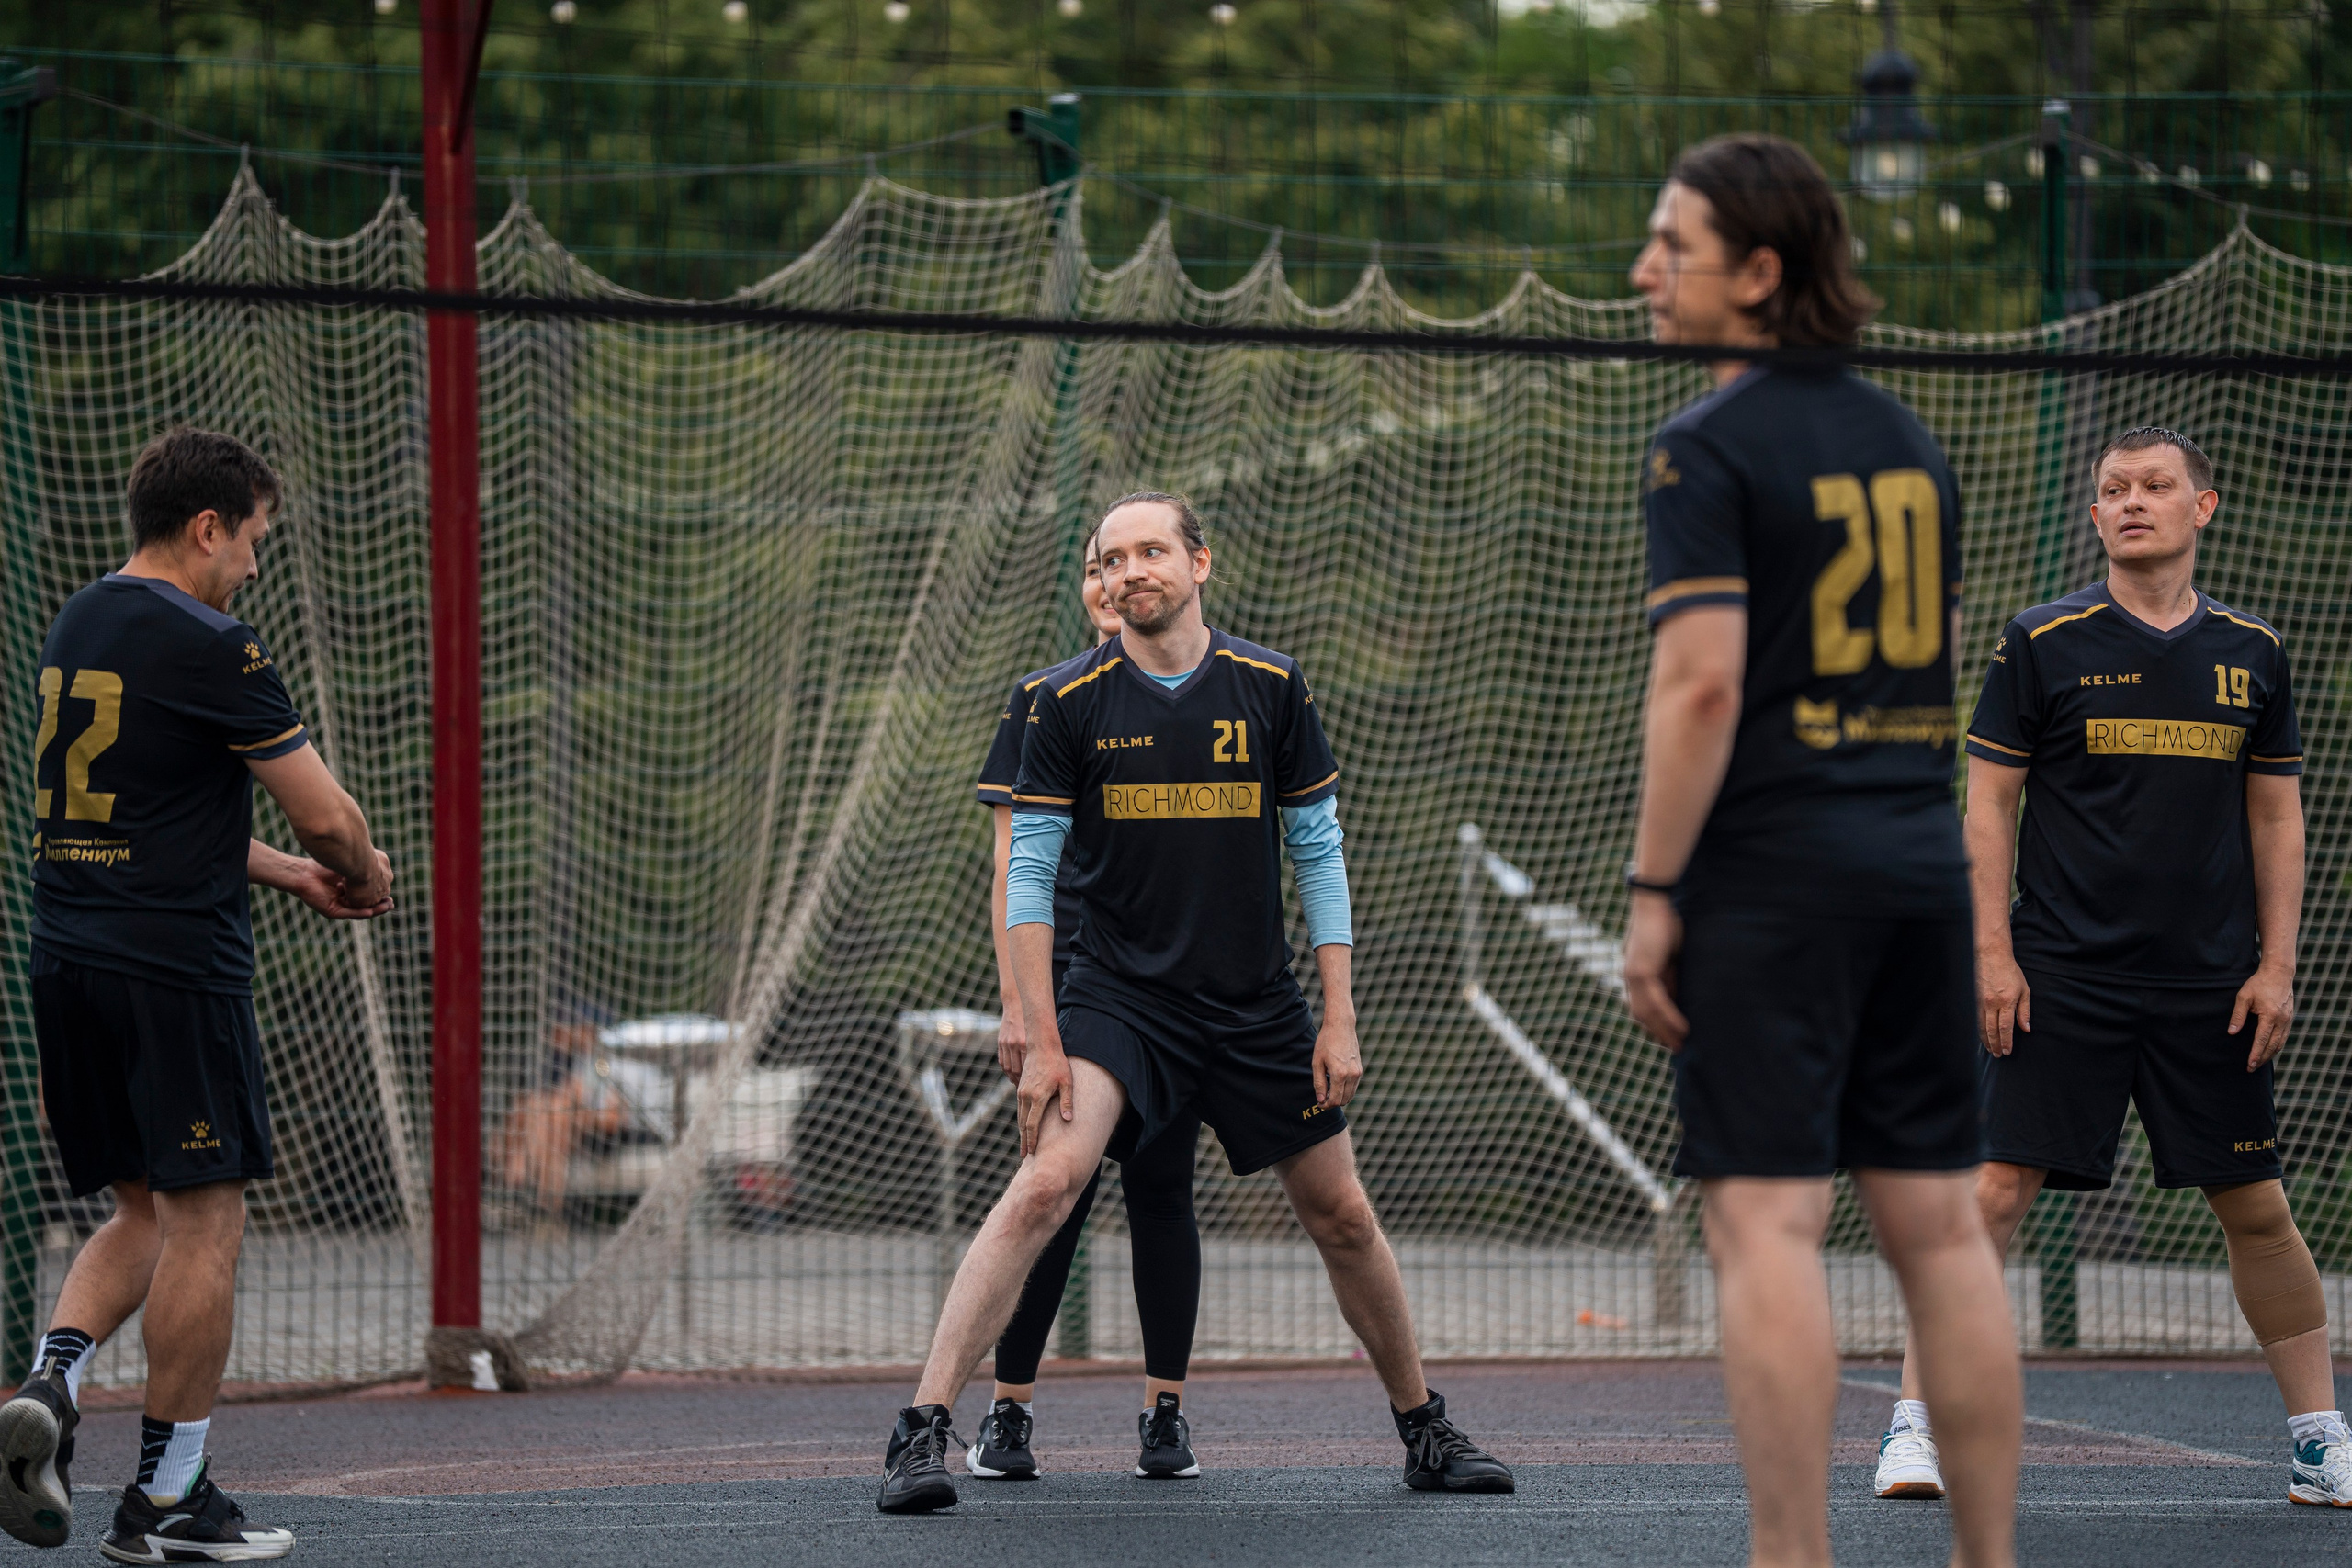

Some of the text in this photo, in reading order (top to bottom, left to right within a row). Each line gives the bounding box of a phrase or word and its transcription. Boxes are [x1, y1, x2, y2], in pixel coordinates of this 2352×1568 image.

[1810, 466, 1944, 677] 20
[1993, 653, 2007, 663] LME
[2080, 673, 2143, 686] KELME
[2213, 663, 2251, 709] 19
[1026, 715, 1040, 724] LME
[33, 666, 124, 823] 22
[1096, 735, 1154, 750] KELME
[1212, 719, 1250, 763] 21
[2094, 723, 2241, 754] RICHMOND
[1109, 786, 1253, 813] RICHMOND
[181, 1138, 221, 1150] KELME
[2234, 1137, 2276, 1152] KELME
